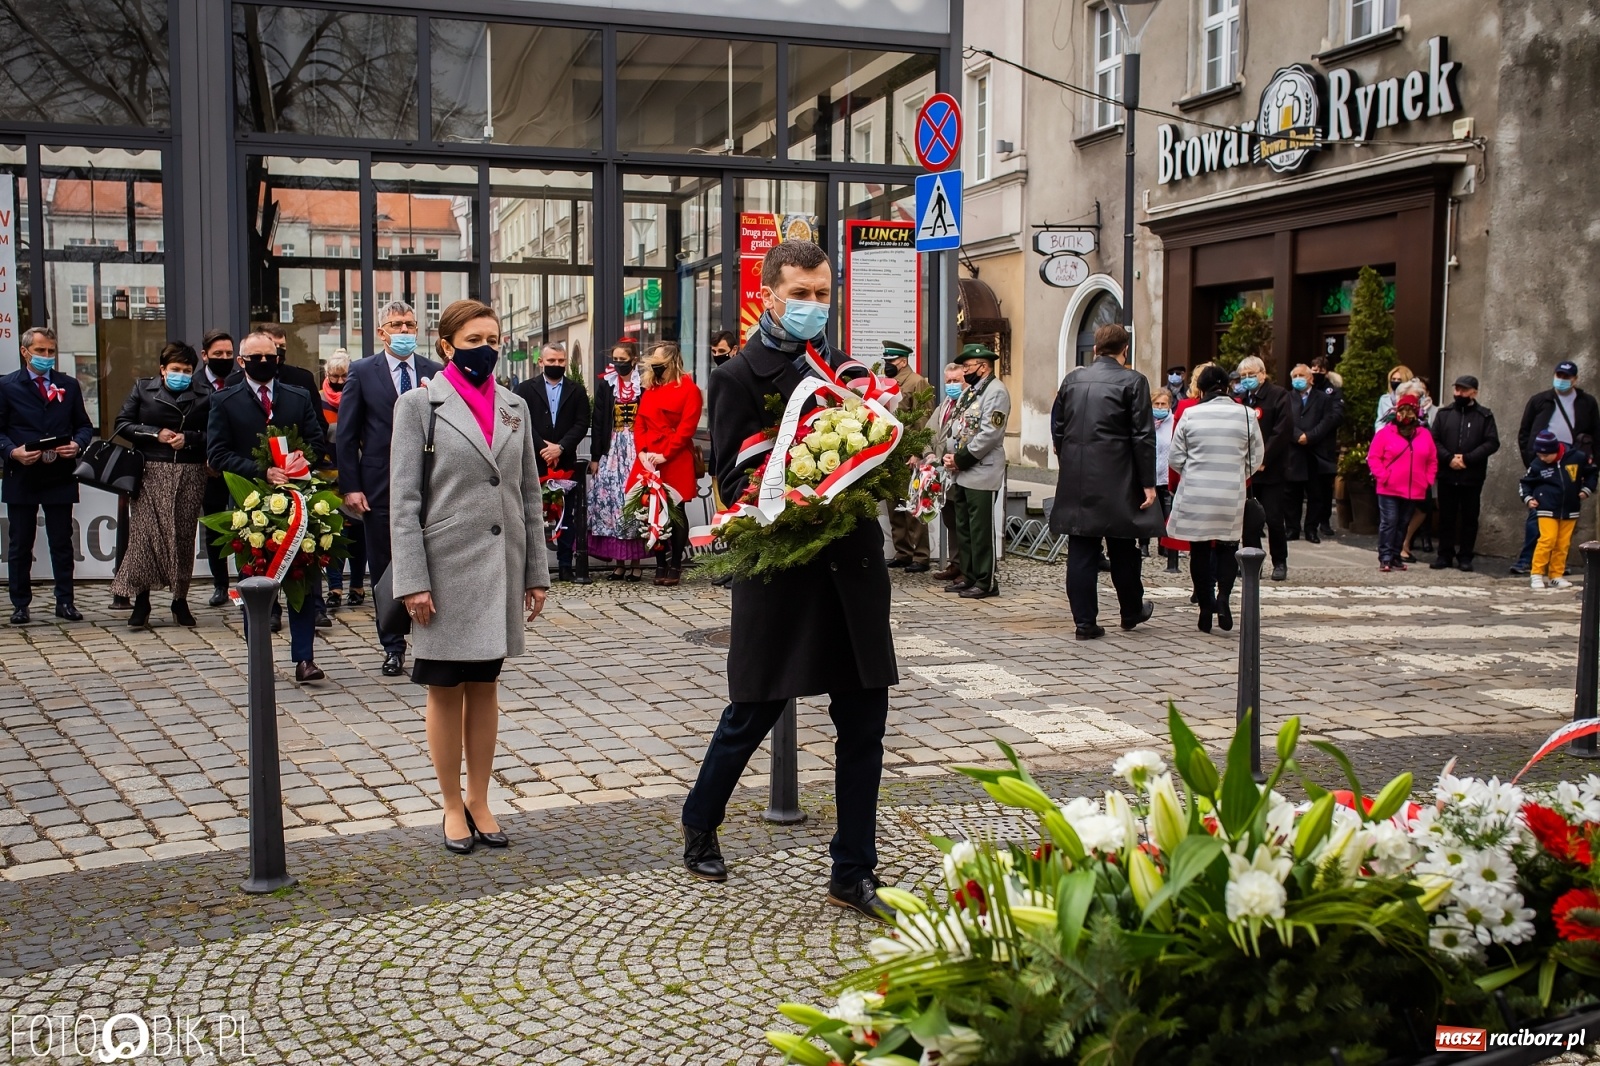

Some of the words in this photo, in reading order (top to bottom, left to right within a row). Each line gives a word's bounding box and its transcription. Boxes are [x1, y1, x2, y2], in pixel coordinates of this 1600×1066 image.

[1158, 119, 1255, 185] Browar
[1328, 36, 1456, 148] Rynek
[1260, 138, 1287, 159] Browar
[1289, 127, 1315, 150] Rynek
[742, 215, 757, 224] Pizza
[758, 216, 774, 225] Time
[742, 227, 761, 239] Druga
[762, 228, 777, 239] pizza
[860, 227, 909, 241] LUNCH
[750, 239, 773, 251] gratis!
[1050, 234, 1083, 249] BUTIK
